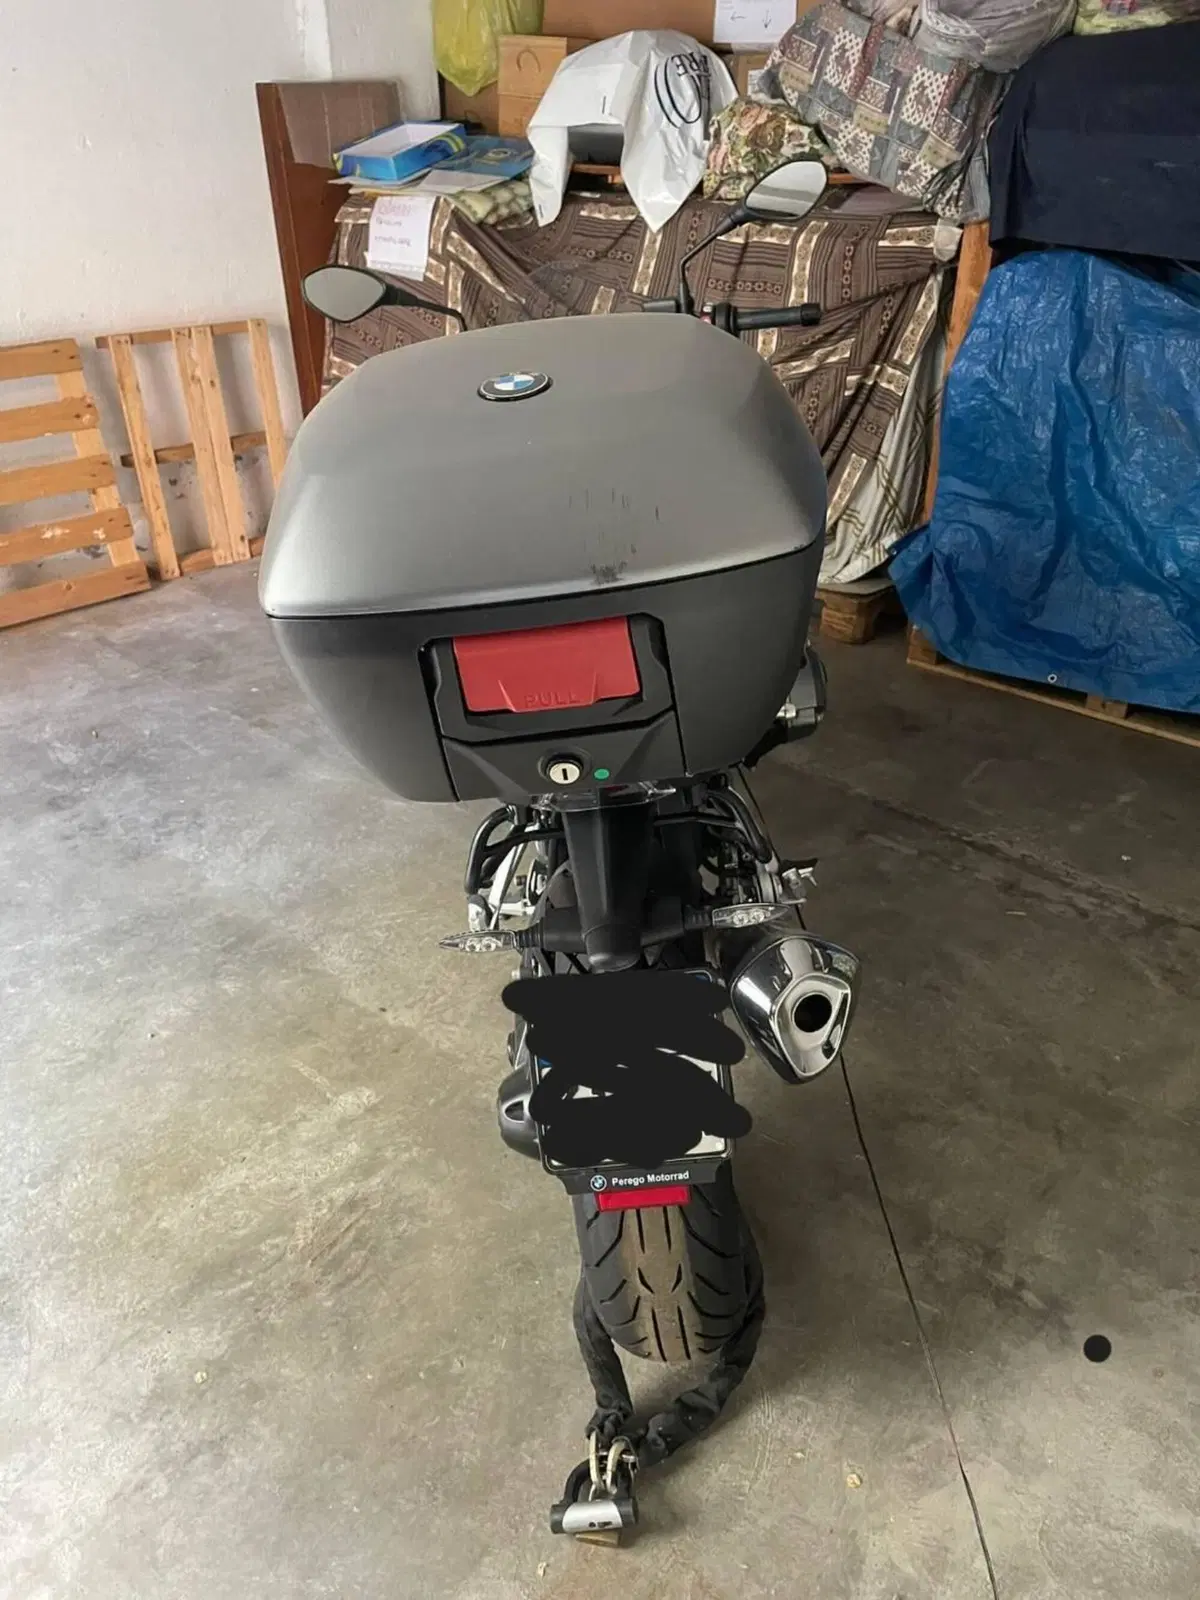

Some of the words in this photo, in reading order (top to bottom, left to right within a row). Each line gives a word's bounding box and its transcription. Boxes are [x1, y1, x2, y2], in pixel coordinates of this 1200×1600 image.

[524, 692, 580, 708] PULL
[612, 1176, 645, 1187] Perego
[647, 1170, 689, 1182] Motorrad
